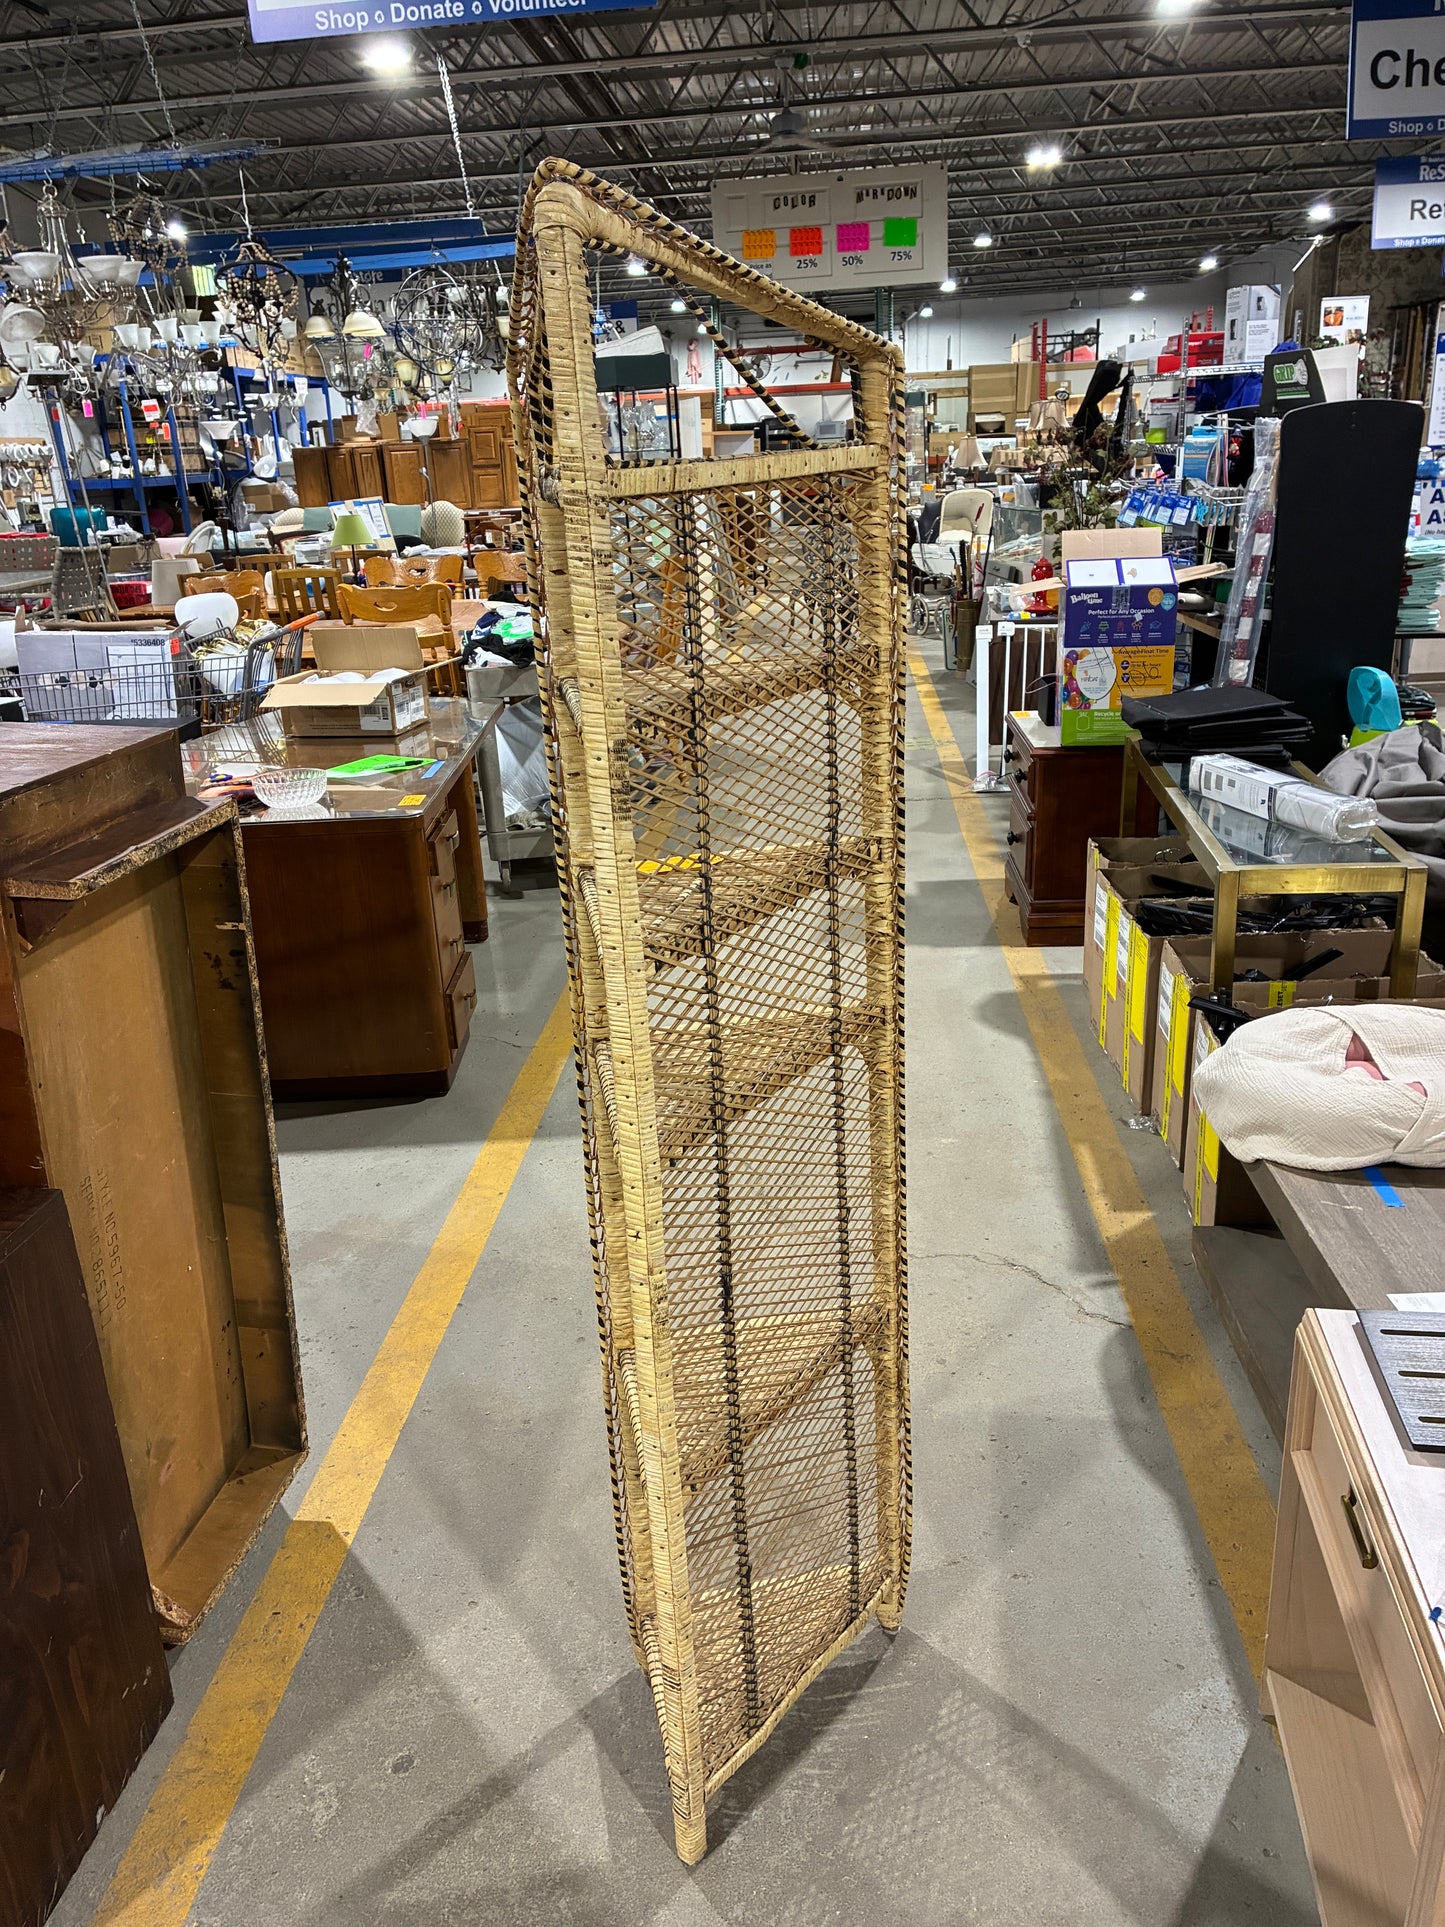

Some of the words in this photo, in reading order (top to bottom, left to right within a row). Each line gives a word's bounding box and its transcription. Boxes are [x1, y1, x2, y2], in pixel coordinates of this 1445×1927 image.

[315, 10, 370, 31] Shop
[390, 1, 464, 23] Donate
[1388, 120, 1424, 135] Shop
[772, 193, 817, 211] COLOR
[1410, 198, 1445, 221] Re
[1394, 238, 1415, 248] Shop
[841, 255, 864, 267] 50%
[890, 250, 912, 262] 75%
[796, 258, 818, 270] 25%
[1274, 364, 1295, 382] GRIP
[1426, 509, 1445, 525] A
[1070, 592, 1099, 605] Balloon
[1088, 608, 1109, 616] Perfect
[1118, 608, 1129, 616] Any
[1130, 607, 1155, 615] Occasion
[1094, 711, 1115, 719] Recycle
